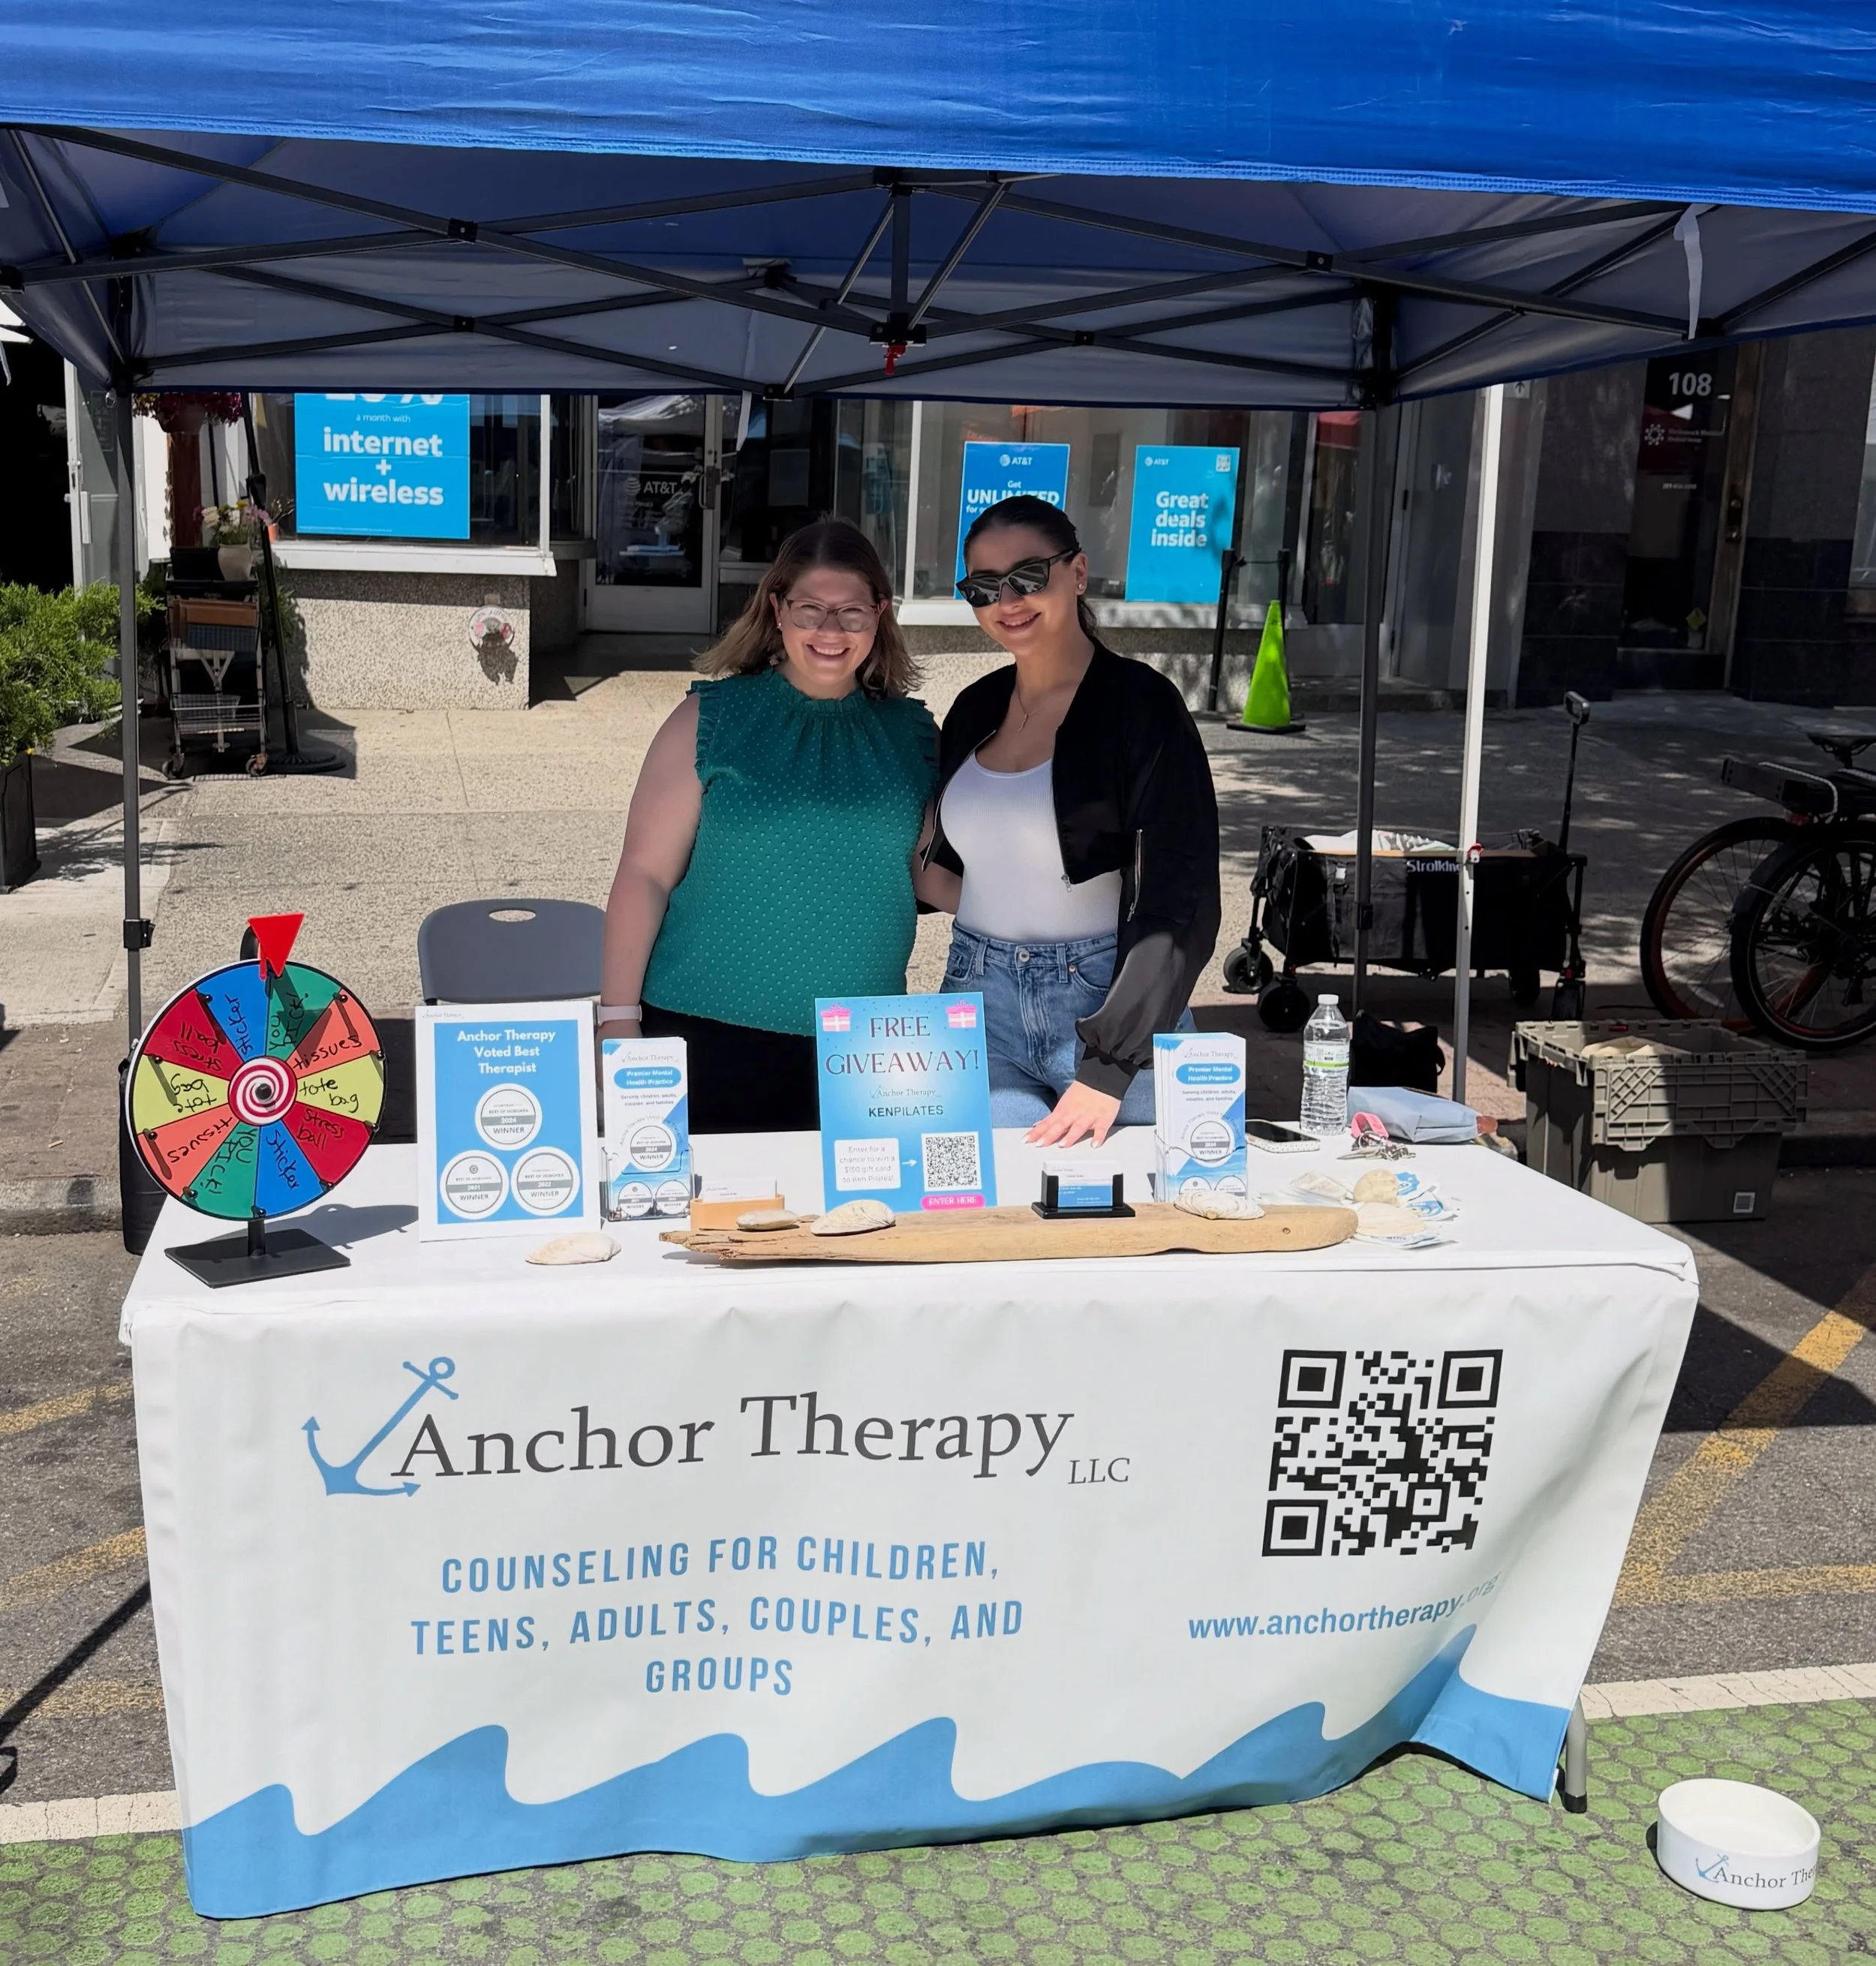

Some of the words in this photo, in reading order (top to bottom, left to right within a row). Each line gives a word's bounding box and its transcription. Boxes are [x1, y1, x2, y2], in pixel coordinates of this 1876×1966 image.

[1668, 372, 1712, 397] 108
[323, 426, 443, 458] internet
[1012, 456, 1033, 465] AT&T
[323, 476, 444, 506] wireless
[643, 481, 678, 495] AT&T
[1007, 479, 1022, 488] Get
[966, 505, 979, 513] for
[1156, 491, 1209, 509] Great
[1156, 510, 1206, 528] deals
[1151, 528, 1207, 547] inside
[456, 1030, 502, 1042] Anchor
[504, 1029, 556, 1042] Therapy
[870, 1015, 930, 1038] FREE
[293, 1035, 362, 1069] tissues
[474, 1045, 512, 1057] Voted
[514, 1045, 540, 1057] Best
[1211, 1051, 1234, 1059] Therapy
[478, 1061, 537, 1075] Therapist
[825, 1049, 979, 1075] GIVEAWAY!
[299, 1078, 338, 1096] tote
[877, 1089, 904, 1097] Anchor
[906, 1088, 936, 1097] Therapy
[329, 1093, 359, 1114] bag
[869, 1105, 944, 1117] KENPILATES
[296, 1123, 327, 1151] ball
[928, 1196, 955, 1206] ENTER
[957, 1195, 978, 1204] HERE
[390, 1405, 715, 1477] Anchor
[740, 1390, 1075, 1478] Therapy
[1068, 1457, 1130, 1484] LLC
[441, 1542, 690, 1594] COUNSELING
[708, 1535, 777, 1573] FOR
[797, 1536, 999, 1580] CHILDREN,
[1188, 1571, 1502, 1639] www.anchortherapy.org
[410, 1616, 549, 1655] TEENS,
[570, 1598, 729, 1643] ADULTS,
[750, 1596, 931, 1647] COUPLES,
[950, 1600, 1024, 1640] AND
[645, 1657, 794, 1697] GROUPS
[1713, 1866, 1786, 1889] Anchor
